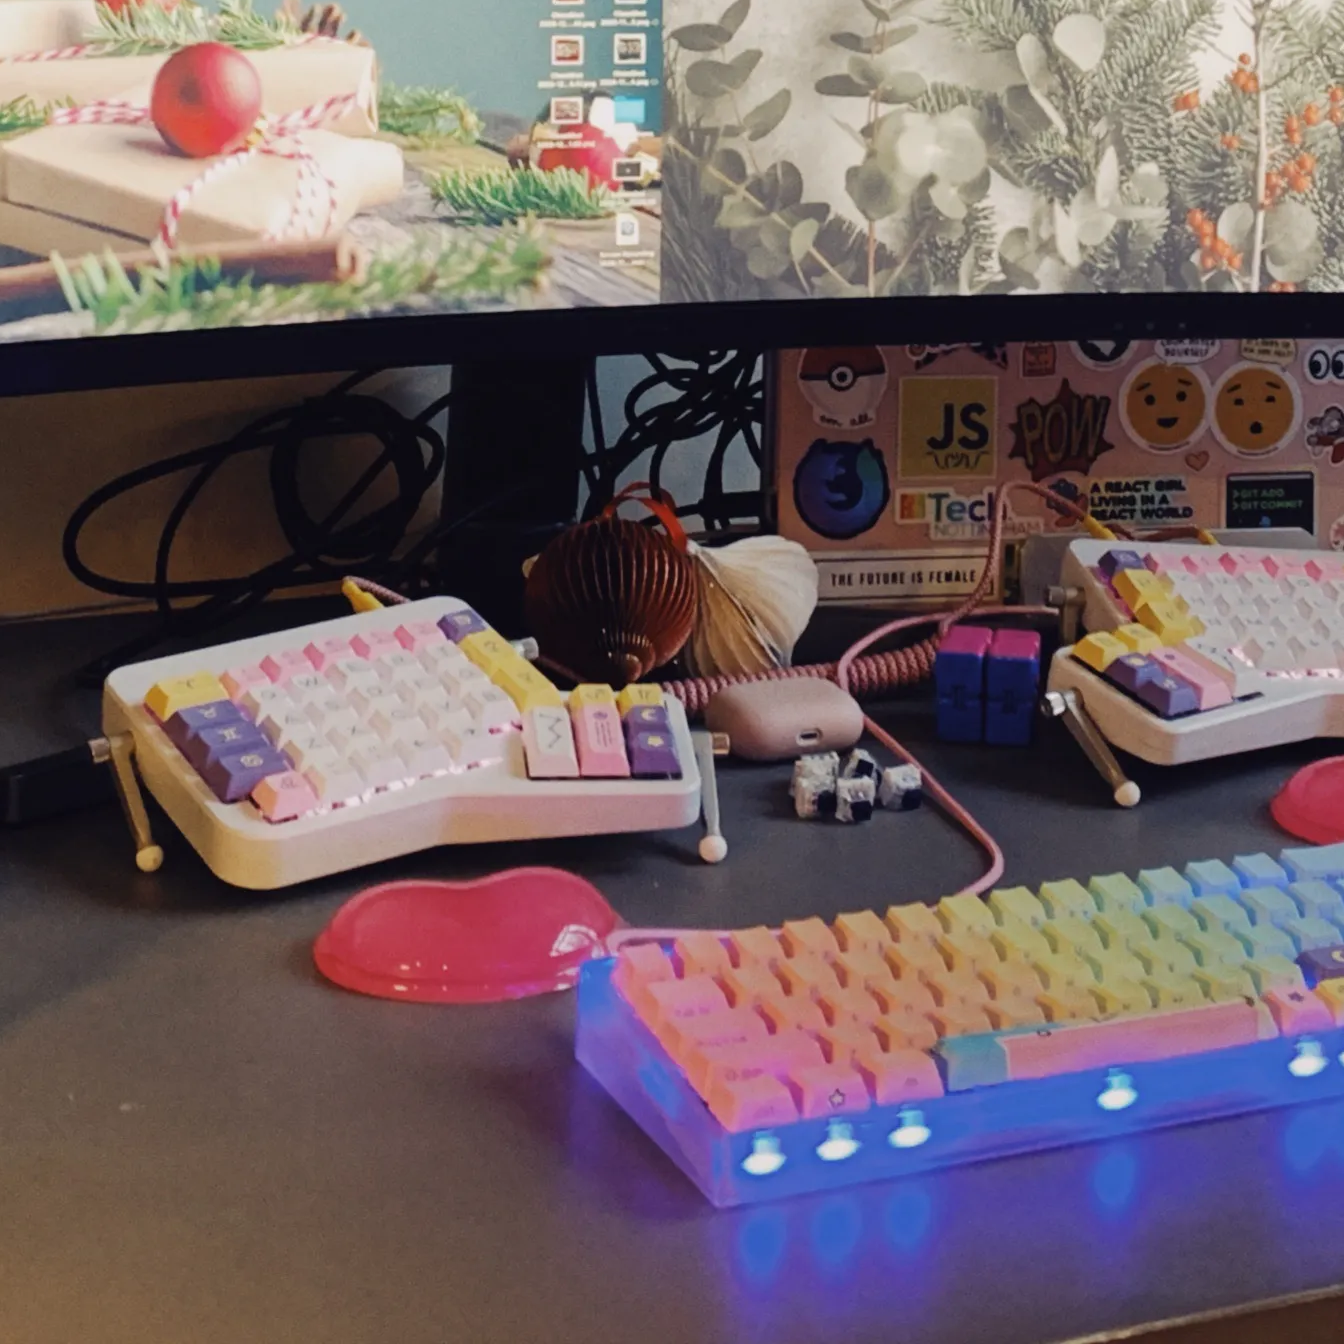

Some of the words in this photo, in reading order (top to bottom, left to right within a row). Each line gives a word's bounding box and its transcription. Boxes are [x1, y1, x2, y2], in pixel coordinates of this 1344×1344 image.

[926, 402, 990, 450] JS
[1018, 397, 1110, 468] POW
[1090, 481, 1101, 494] A
[1104, 480, 1151, 494] REACT
[1155, 479, 1187, 492] GIRL
[1090, 495, 1137, 508] LIVING
[1140, 494, 1155, 506] IN
[1158, 493, 1170, 505] A
[1090, 508, 1137, 521] REACT
[1140, 506, 1194, 520] WORLD
[934, 521, 1041, 537] NOTTINHAM
[831, 572, 854, 587] THE
[859, 571, 906, 586] FUTURE
[911, 570, 924, 584] IS
[928, 569, 977, 584] FEMALE
